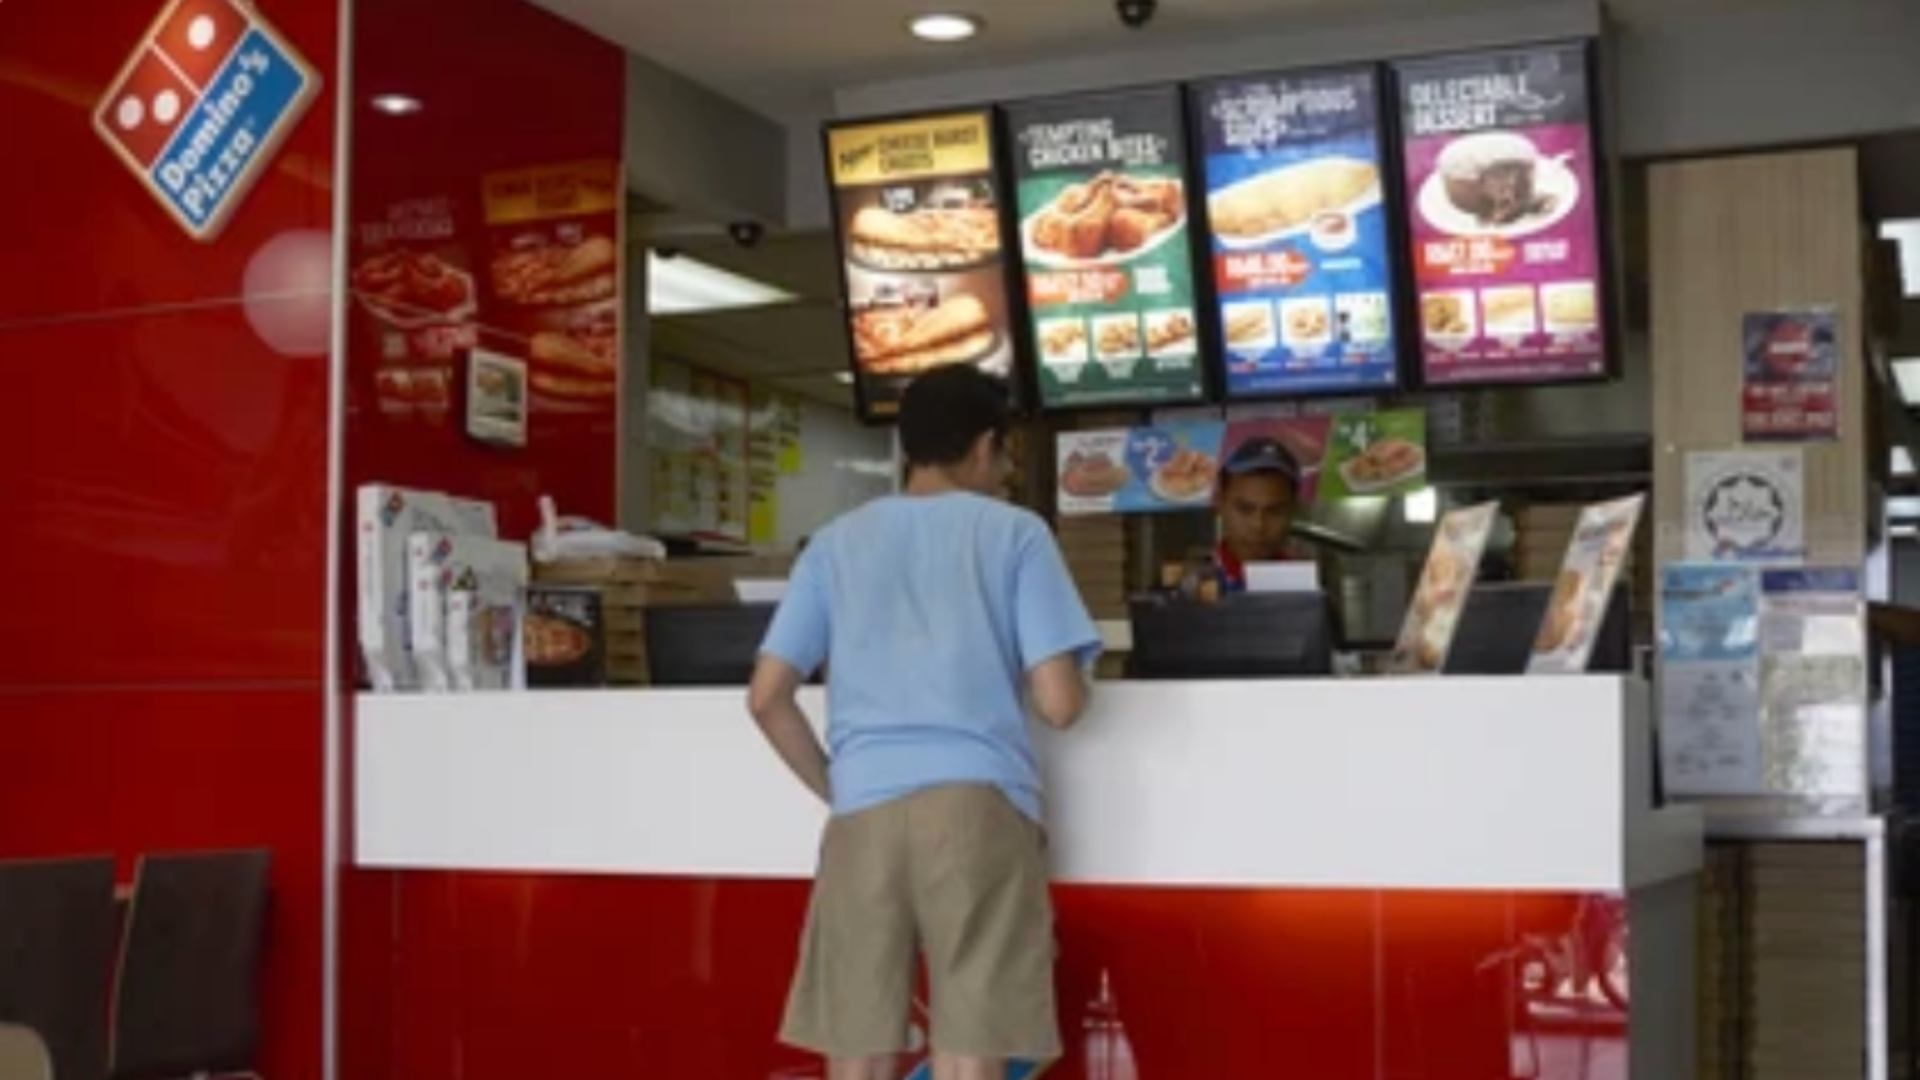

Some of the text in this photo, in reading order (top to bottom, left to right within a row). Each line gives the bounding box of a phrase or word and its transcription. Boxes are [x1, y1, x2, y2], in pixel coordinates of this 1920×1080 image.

[159, 50, 271, 192] Domino's
[1030, 134, 1156, 169] CHICKEN BITES
[181, 127, 254, 219] Pizza
